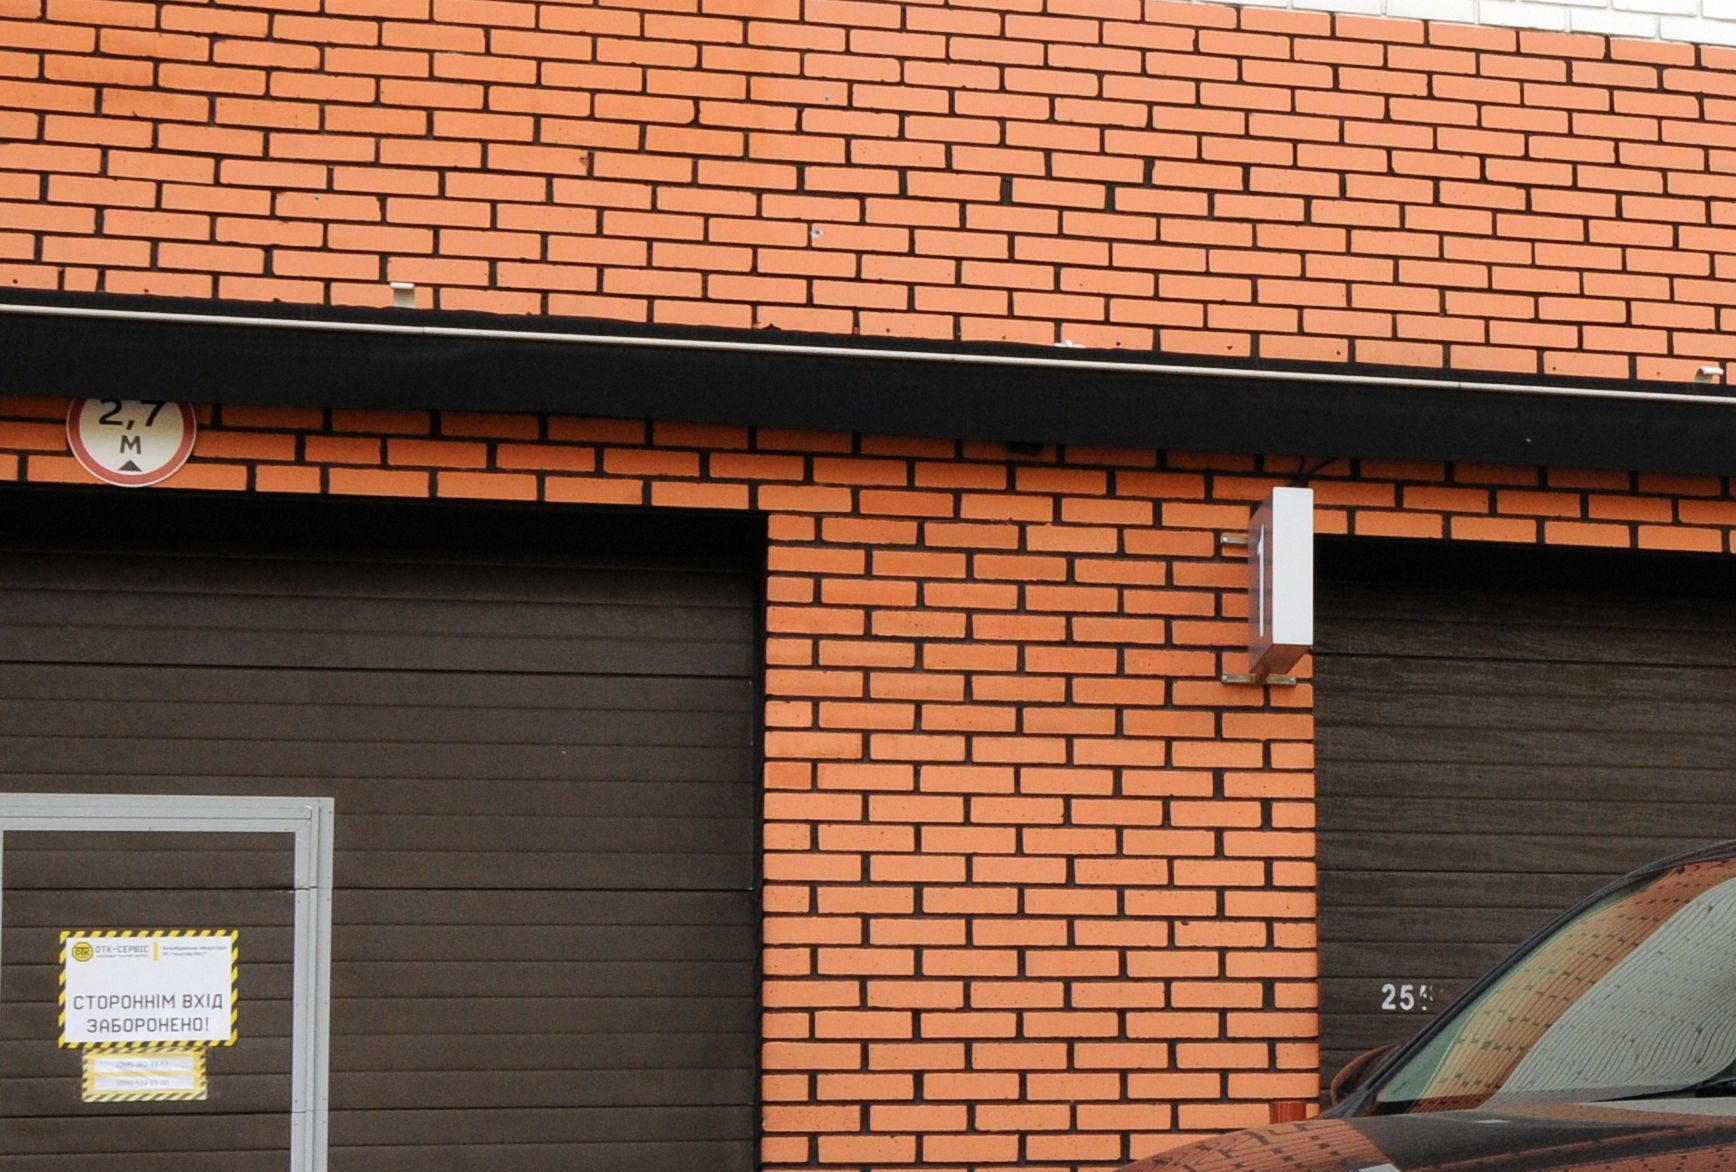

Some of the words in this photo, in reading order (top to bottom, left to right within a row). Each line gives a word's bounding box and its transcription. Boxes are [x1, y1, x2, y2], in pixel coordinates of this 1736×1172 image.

[98, 398, 167, 430] 2,7
[120, 435, 142, 454] М
[73, 994, 176, 1010] СТОРОННІМ
[182, 993, 223, 1010] ВХІД
[87, 1017, 209, 1033] ЗАБОРОНЕНО!
